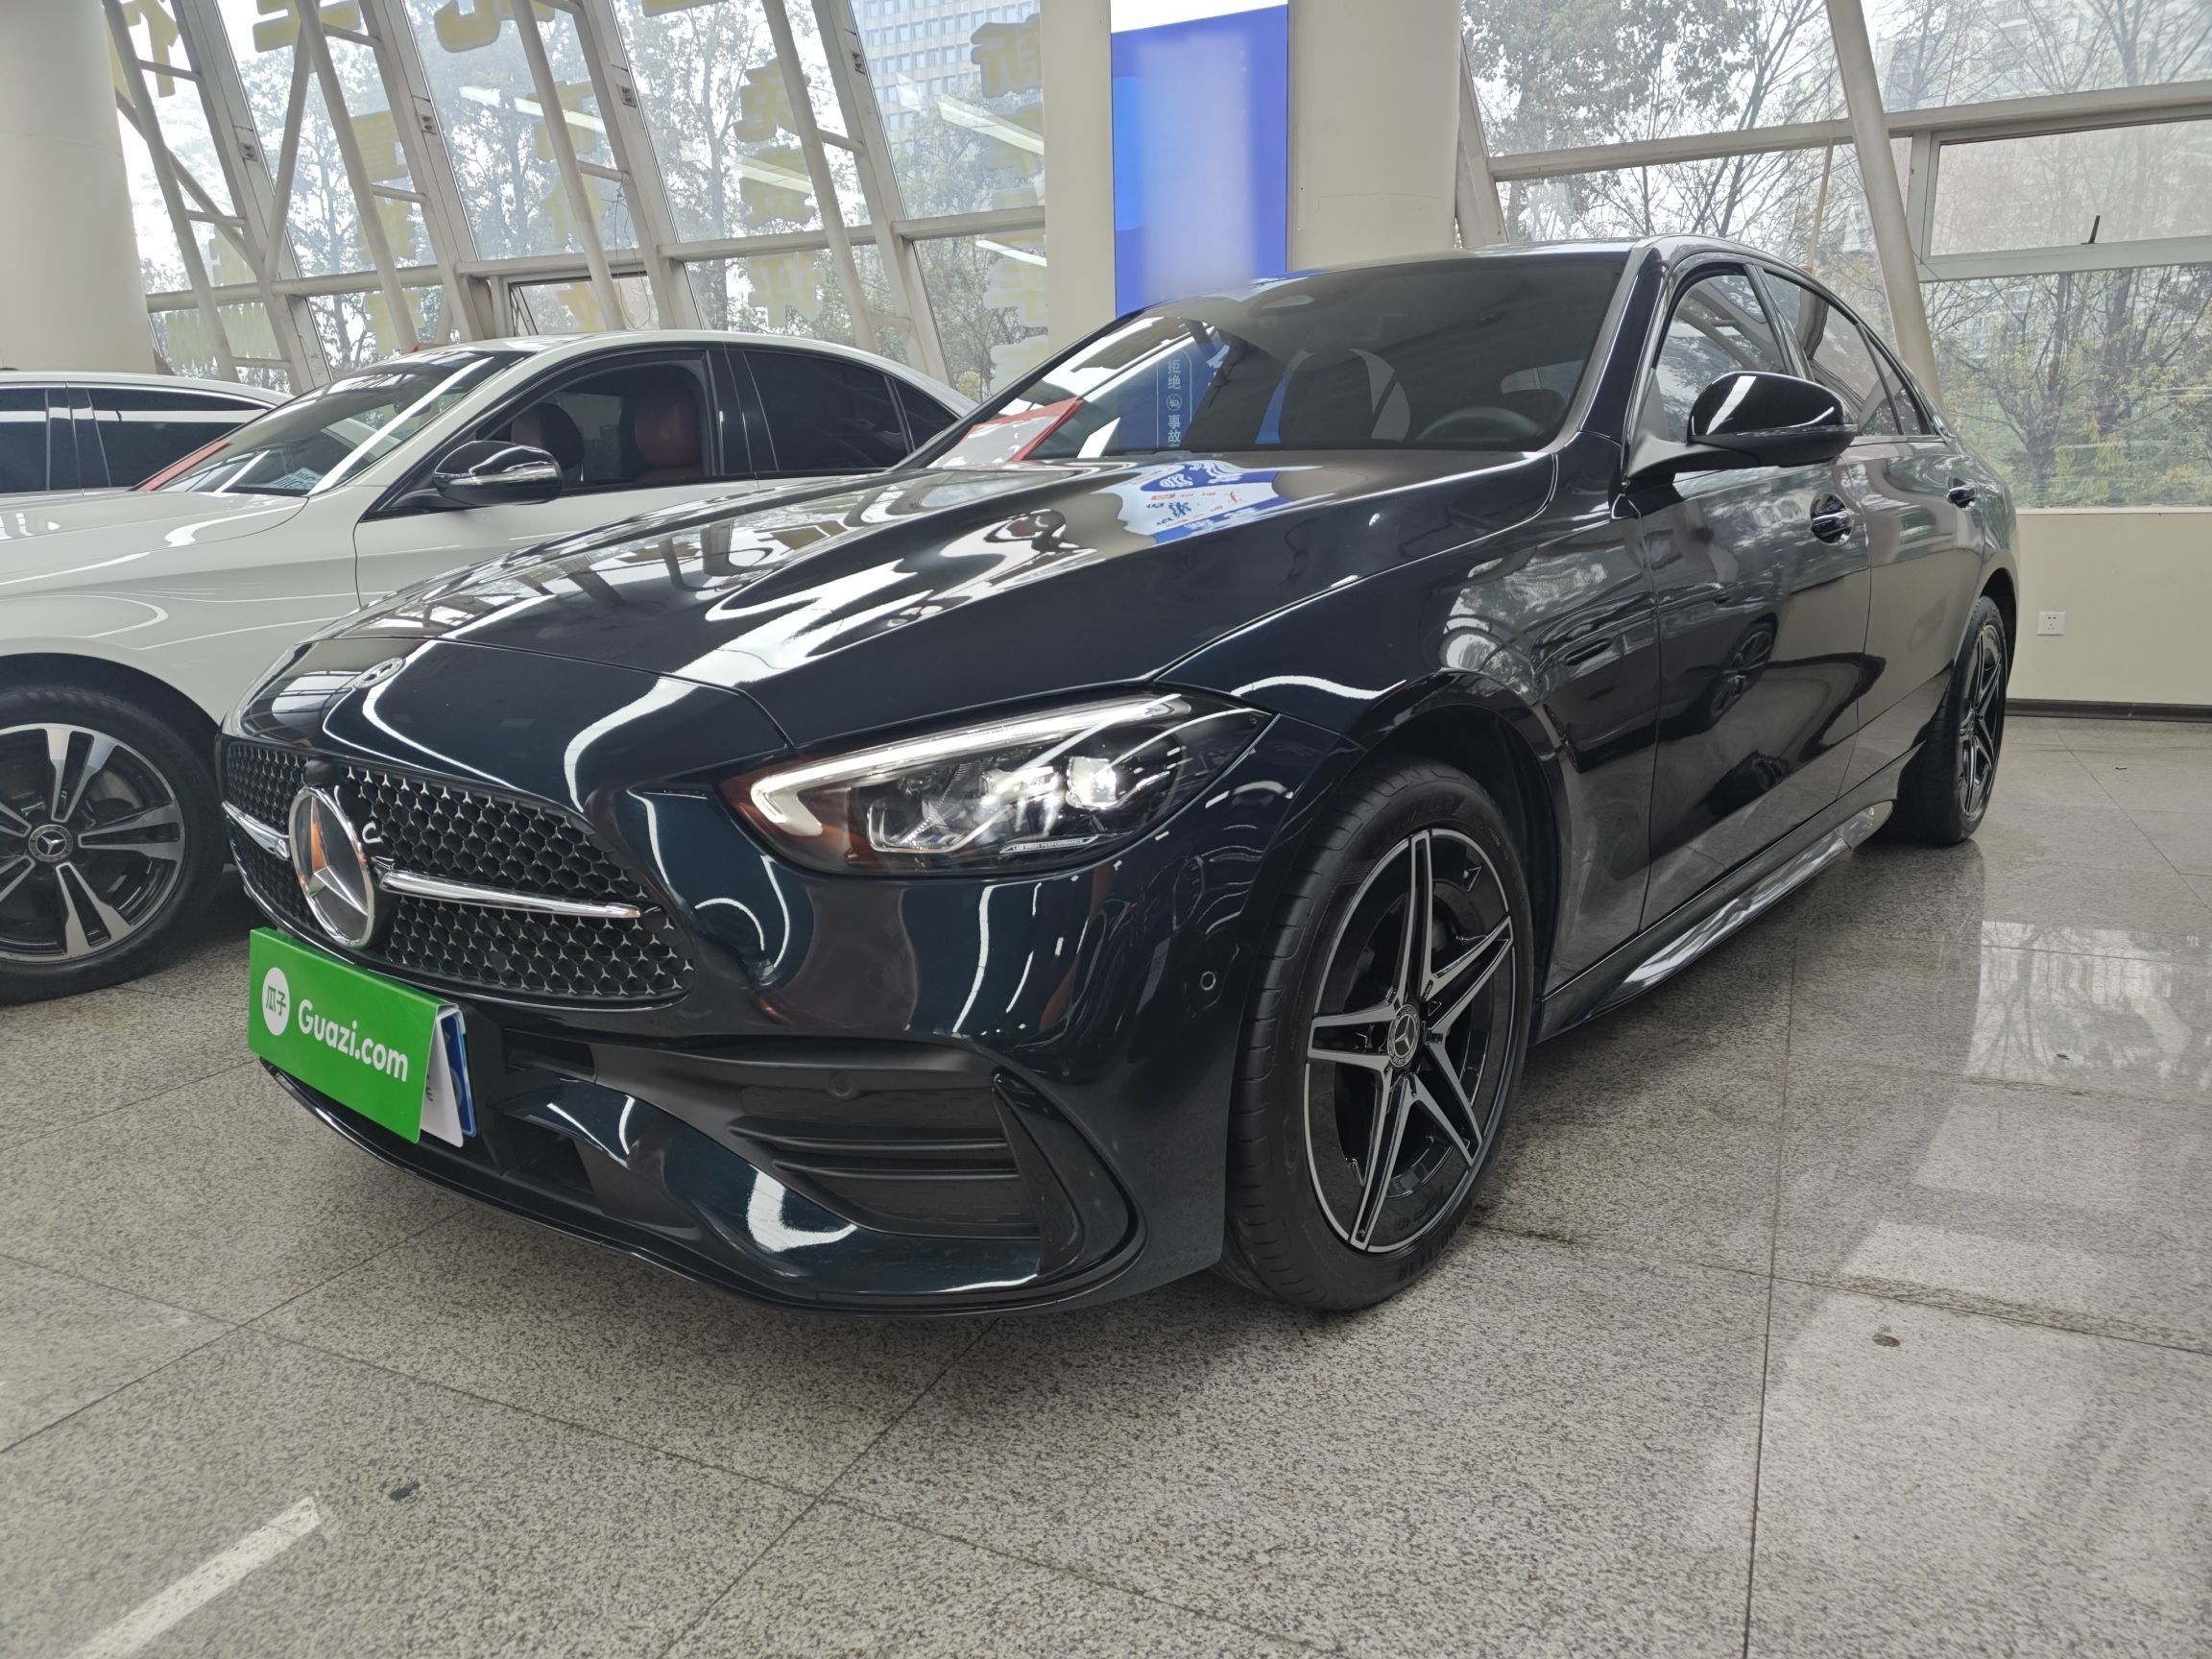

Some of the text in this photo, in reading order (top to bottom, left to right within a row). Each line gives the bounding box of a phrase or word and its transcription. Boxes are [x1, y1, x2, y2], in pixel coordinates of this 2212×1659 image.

[1166, 359, 1182, 390] 拒绝
[265, 985, 287, 1017] 瓜子
[298, 998, 408, 1083] Guazi.com
